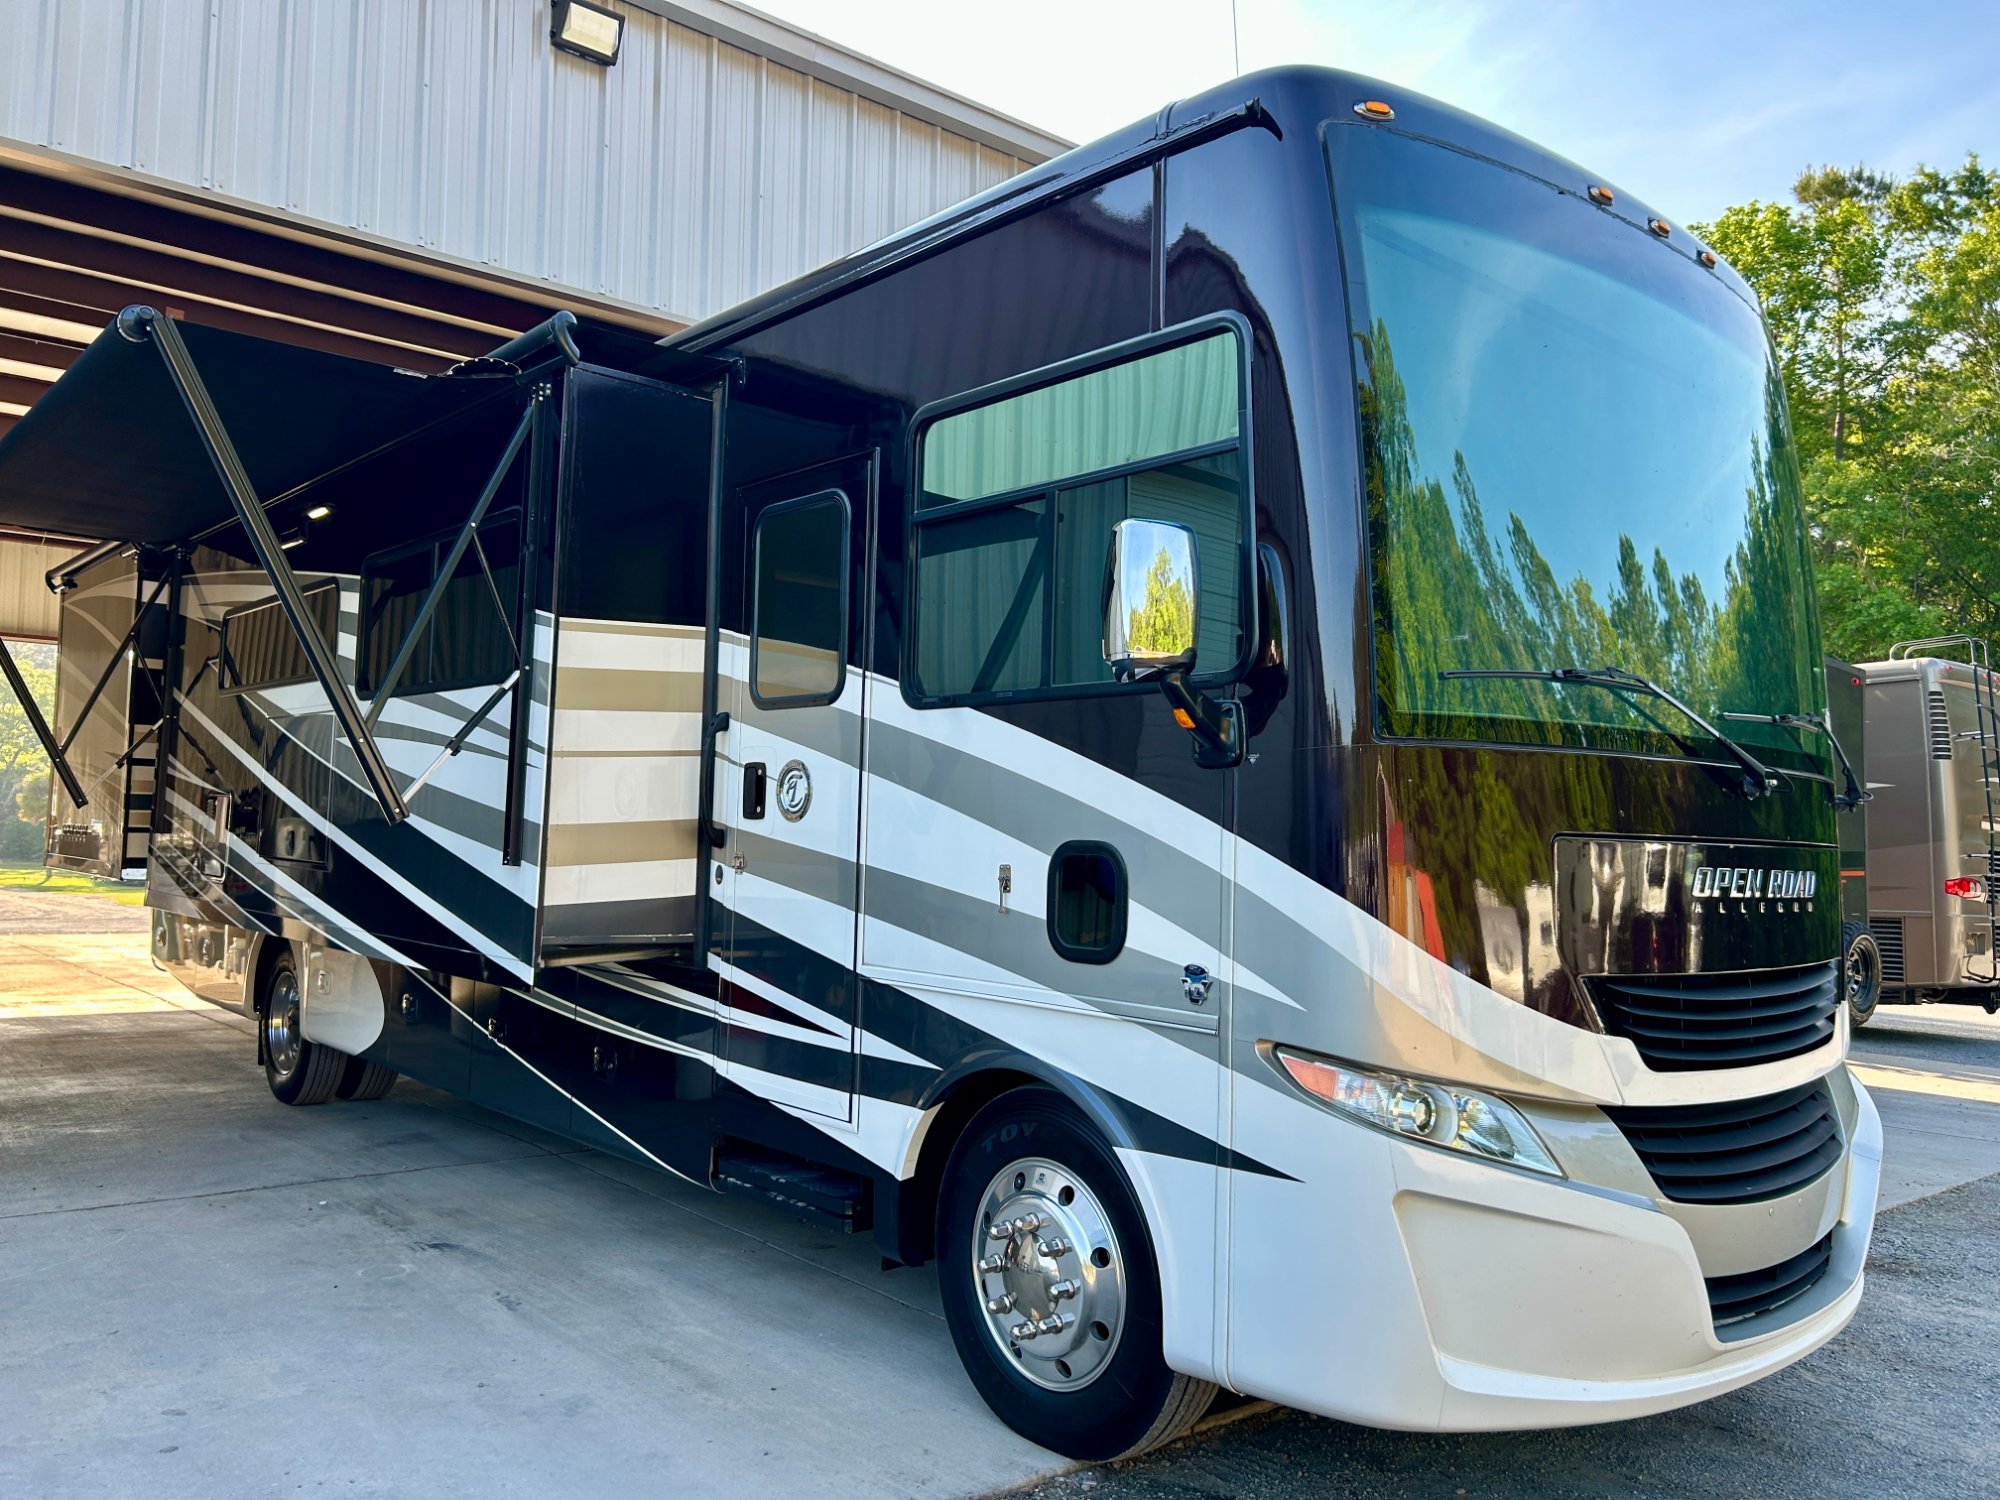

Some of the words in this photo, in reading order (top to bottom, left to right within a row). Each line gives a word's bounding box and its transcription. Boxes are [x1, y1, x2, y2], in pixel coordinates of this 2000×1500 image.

[1692, 867, 1763, 898] OPEN
[1768, 869, 1816, 898] ROAD
[1692, 901, 1813, 914] ALLEGRO
